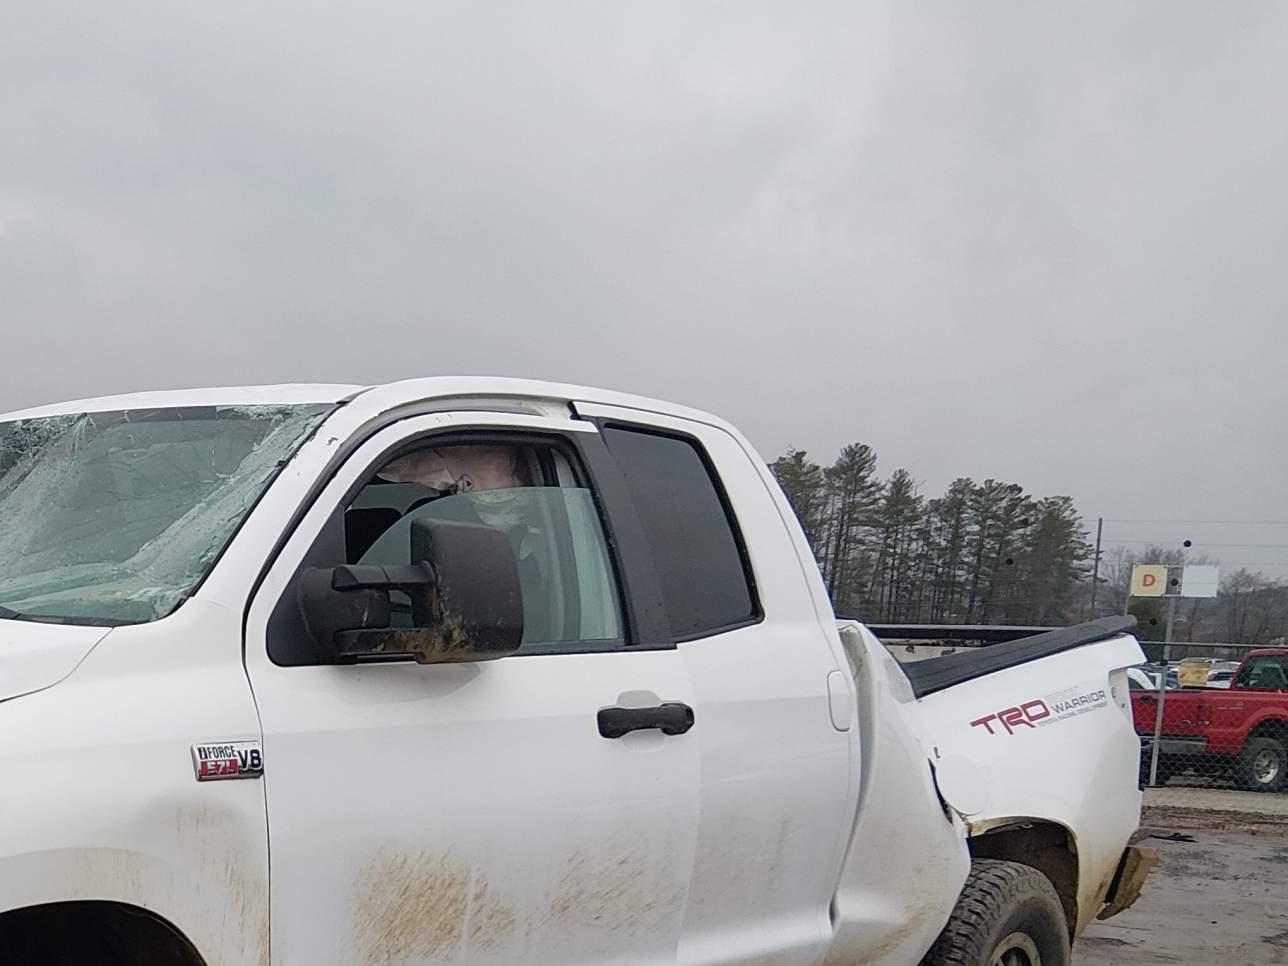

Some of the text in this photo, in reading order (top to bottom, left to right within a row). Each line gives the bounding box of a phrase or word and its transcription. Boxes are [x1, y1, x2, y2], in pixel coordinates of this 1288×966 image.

[1143, 574, 1155, 587] D
[970, 699, 1050, 735] TRD
[1051, 690, 1105, 713] WARRIOR
[237, 748, 262, 769] V8
